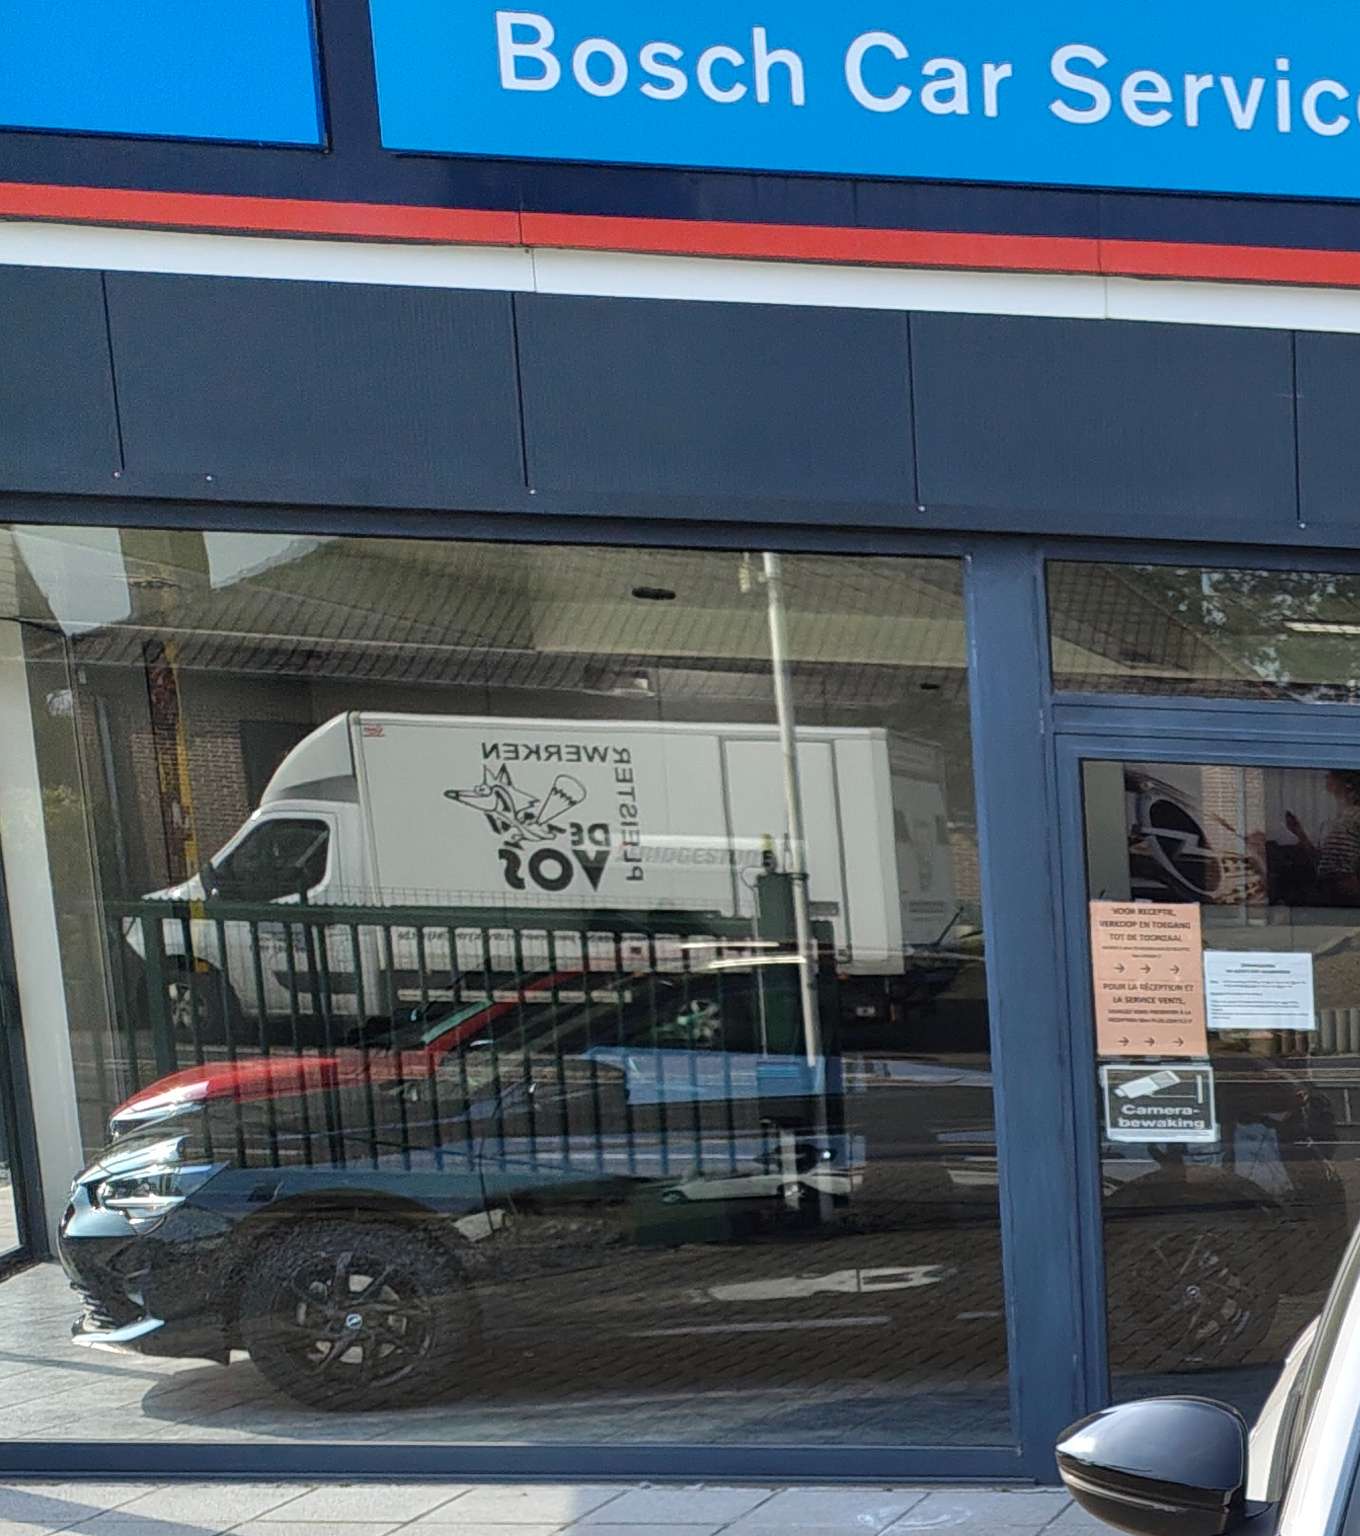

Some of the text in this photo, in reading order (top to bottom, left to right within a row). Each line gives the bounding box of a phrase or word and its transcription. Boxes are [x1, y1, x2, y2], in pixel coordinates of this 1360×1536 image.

[494, 9, 806, 107] Bosch
[843, 30, 1013, 119] Car
[1121, 1104, 1201, 1116] Camera-
[1118, 1117, 1205, 1130] bewaking
